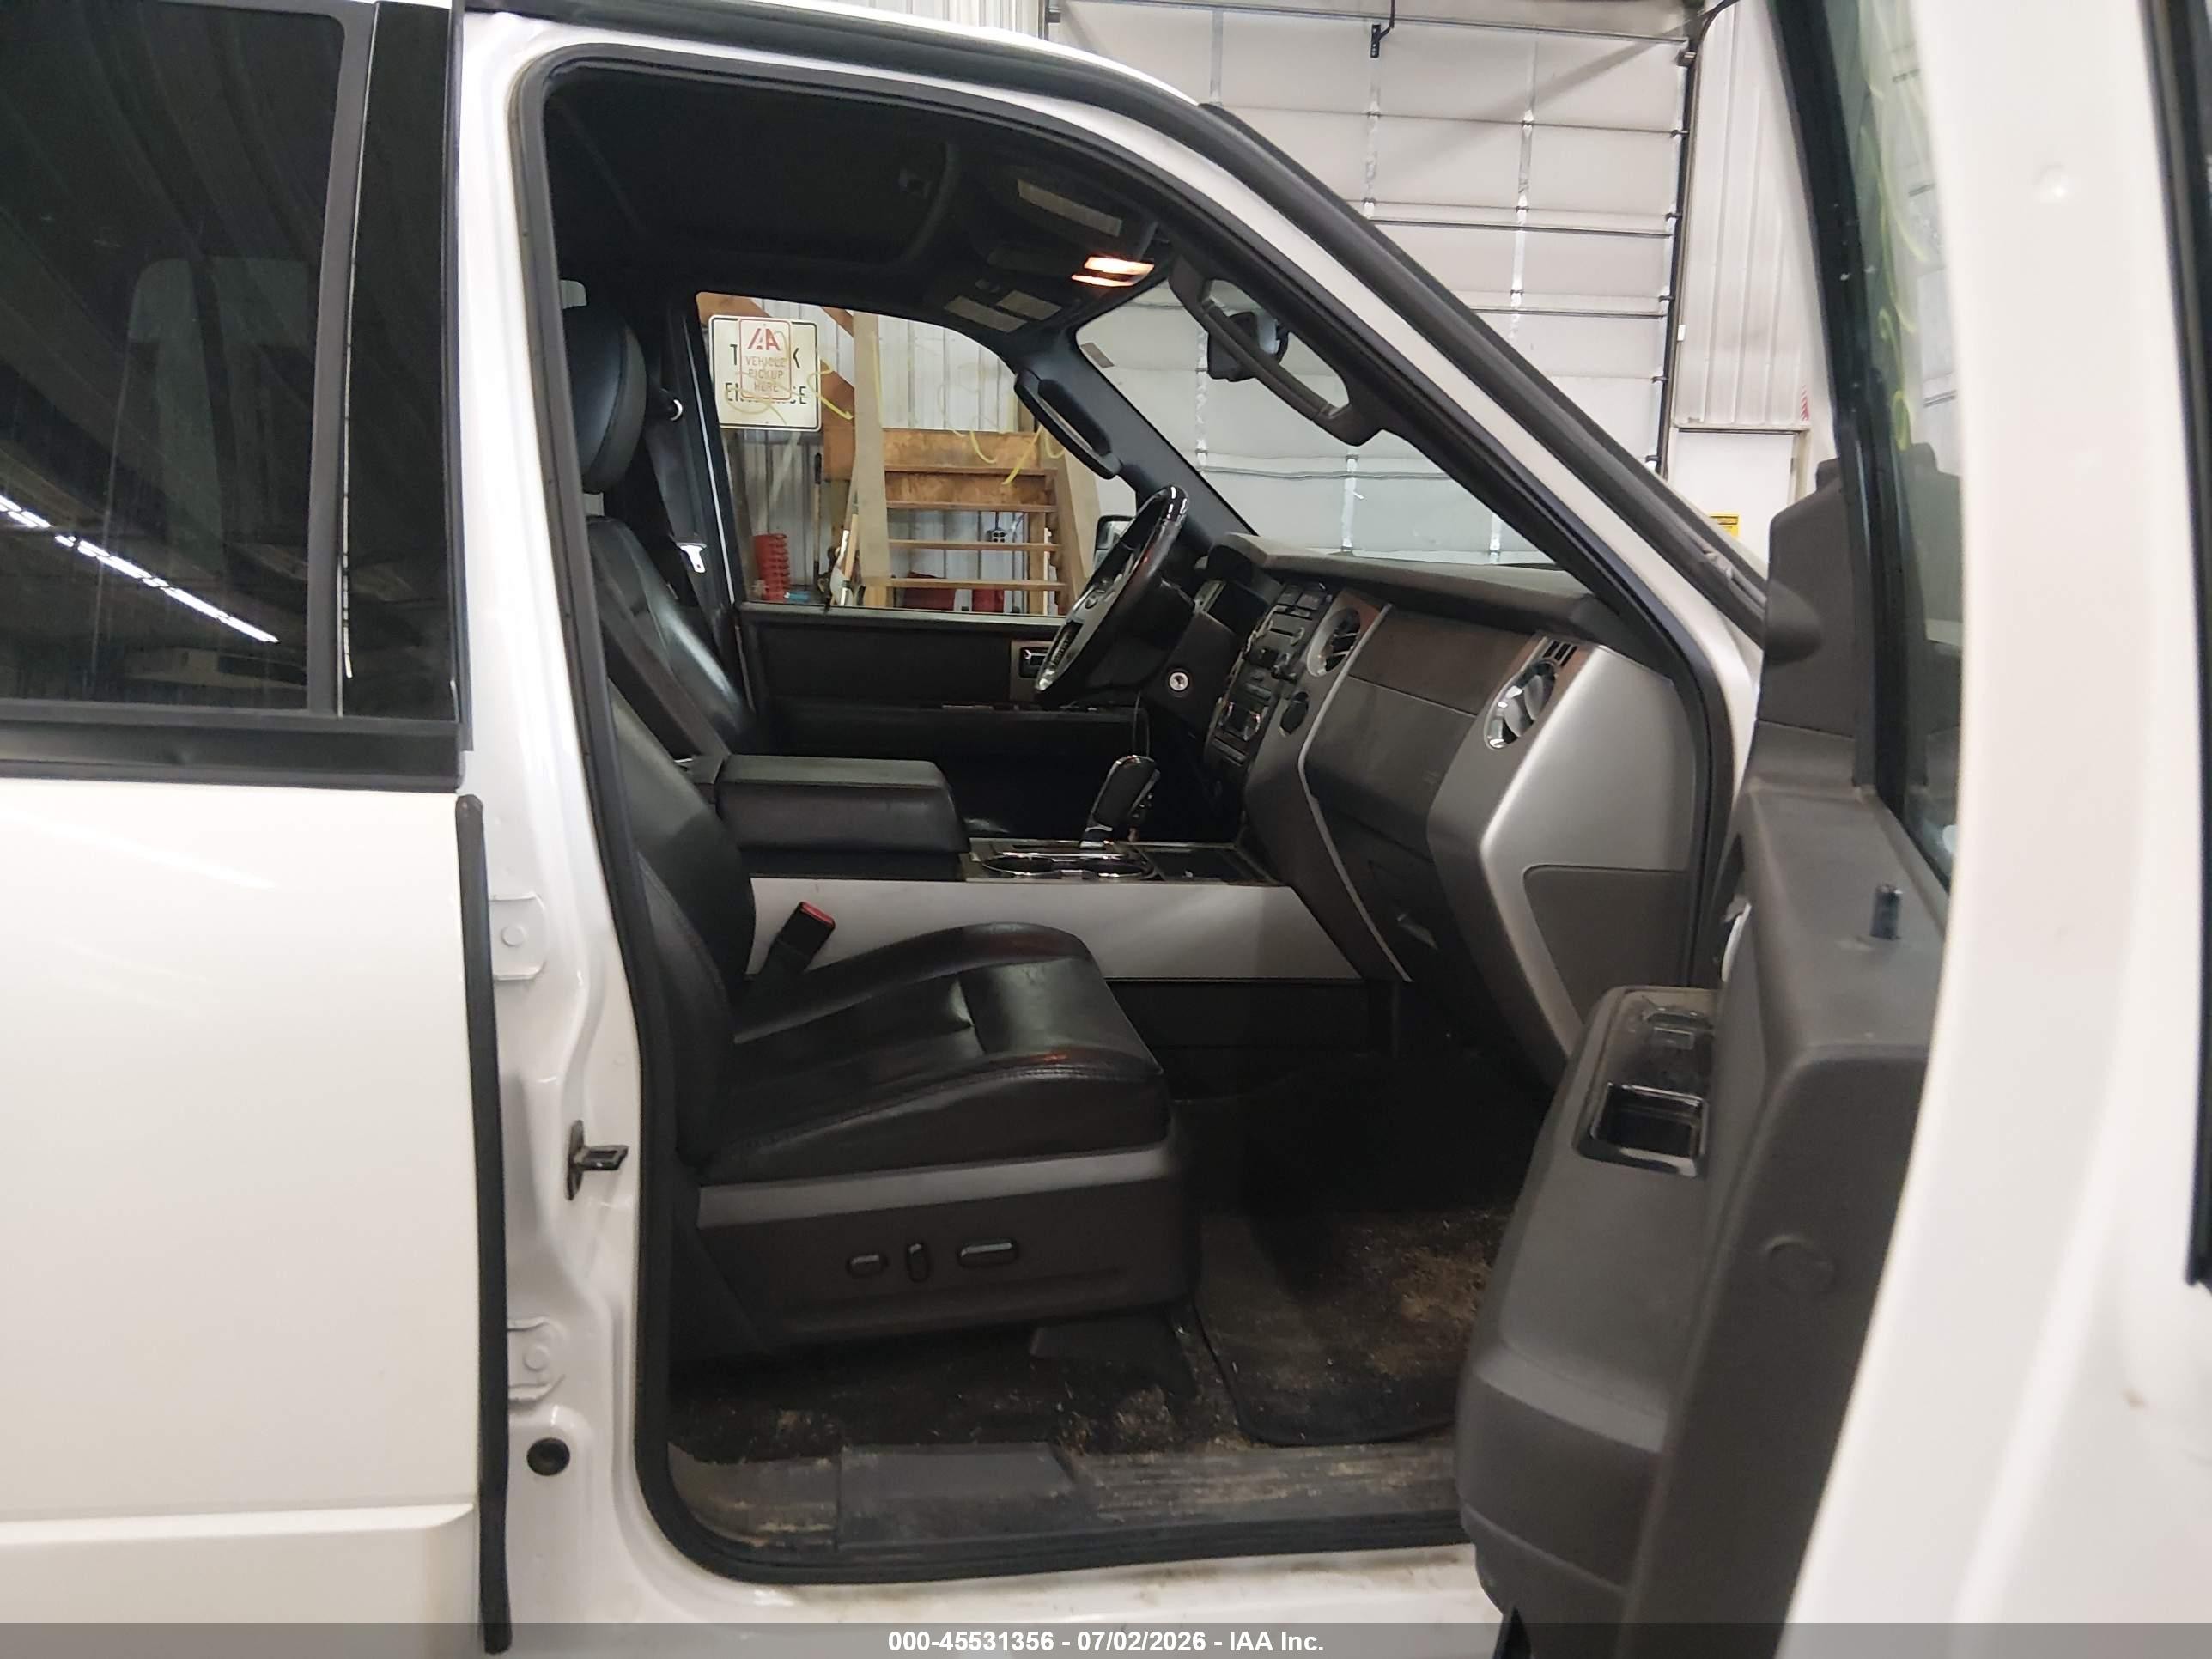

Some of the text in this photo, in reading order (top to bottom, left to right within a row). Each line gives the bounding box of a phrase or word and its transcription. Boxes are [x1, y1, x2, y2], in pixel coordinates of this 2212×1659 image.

[744, 356, 787, 368] VEHICLE
[748, 369, 784, 380] PICKUP
[753, 381, 780, 392] HERE
